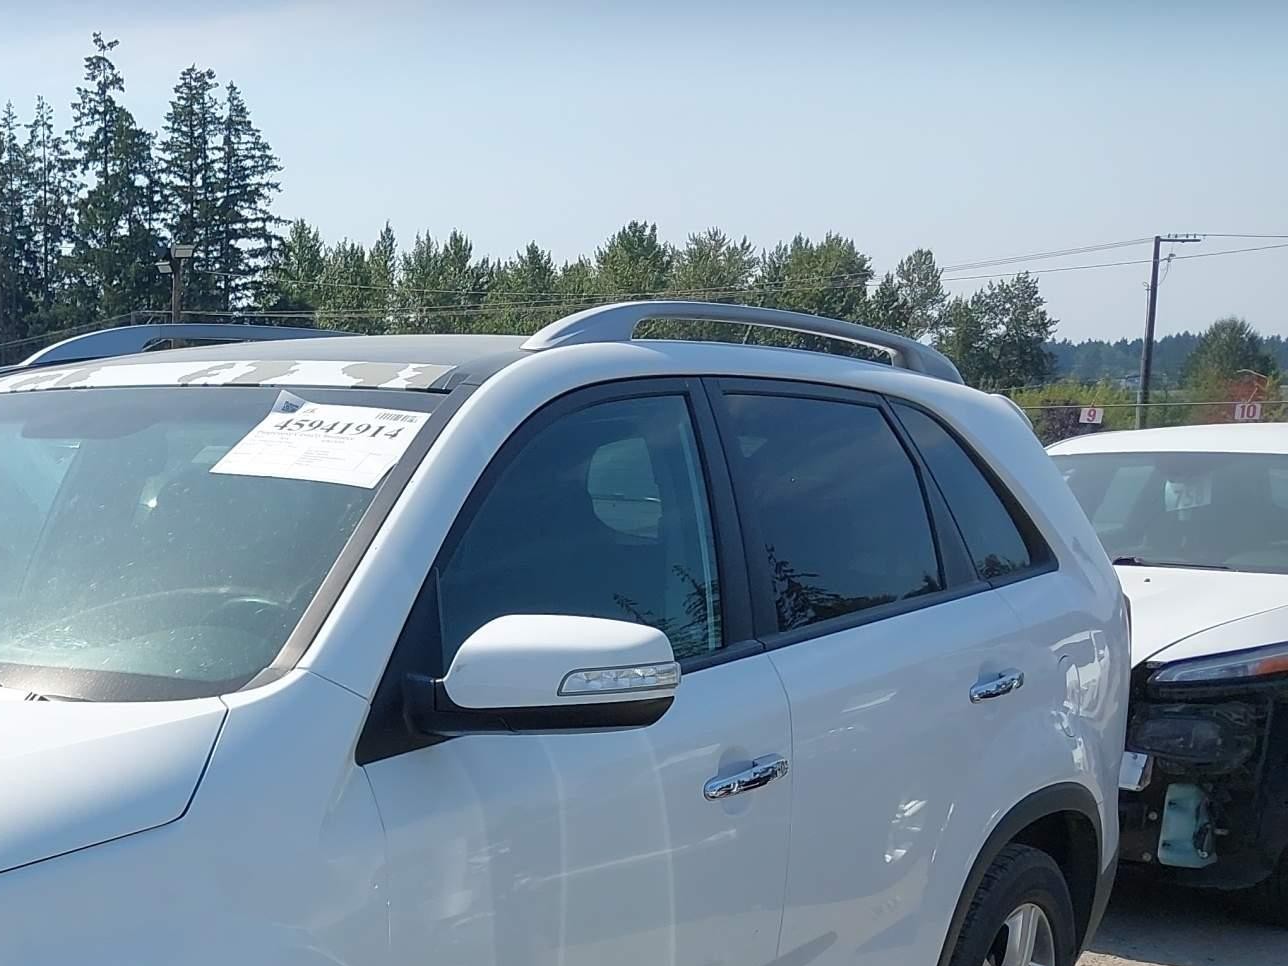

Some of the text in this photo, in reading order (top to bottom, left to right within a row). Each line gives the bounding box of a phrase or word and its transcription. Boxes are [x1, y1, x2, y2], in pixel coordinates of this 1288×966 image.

[1087, 408, 1097, 423] 9
[1240, 403, 1257, 419] 10
[273, 417, 406, 440] 45941914
